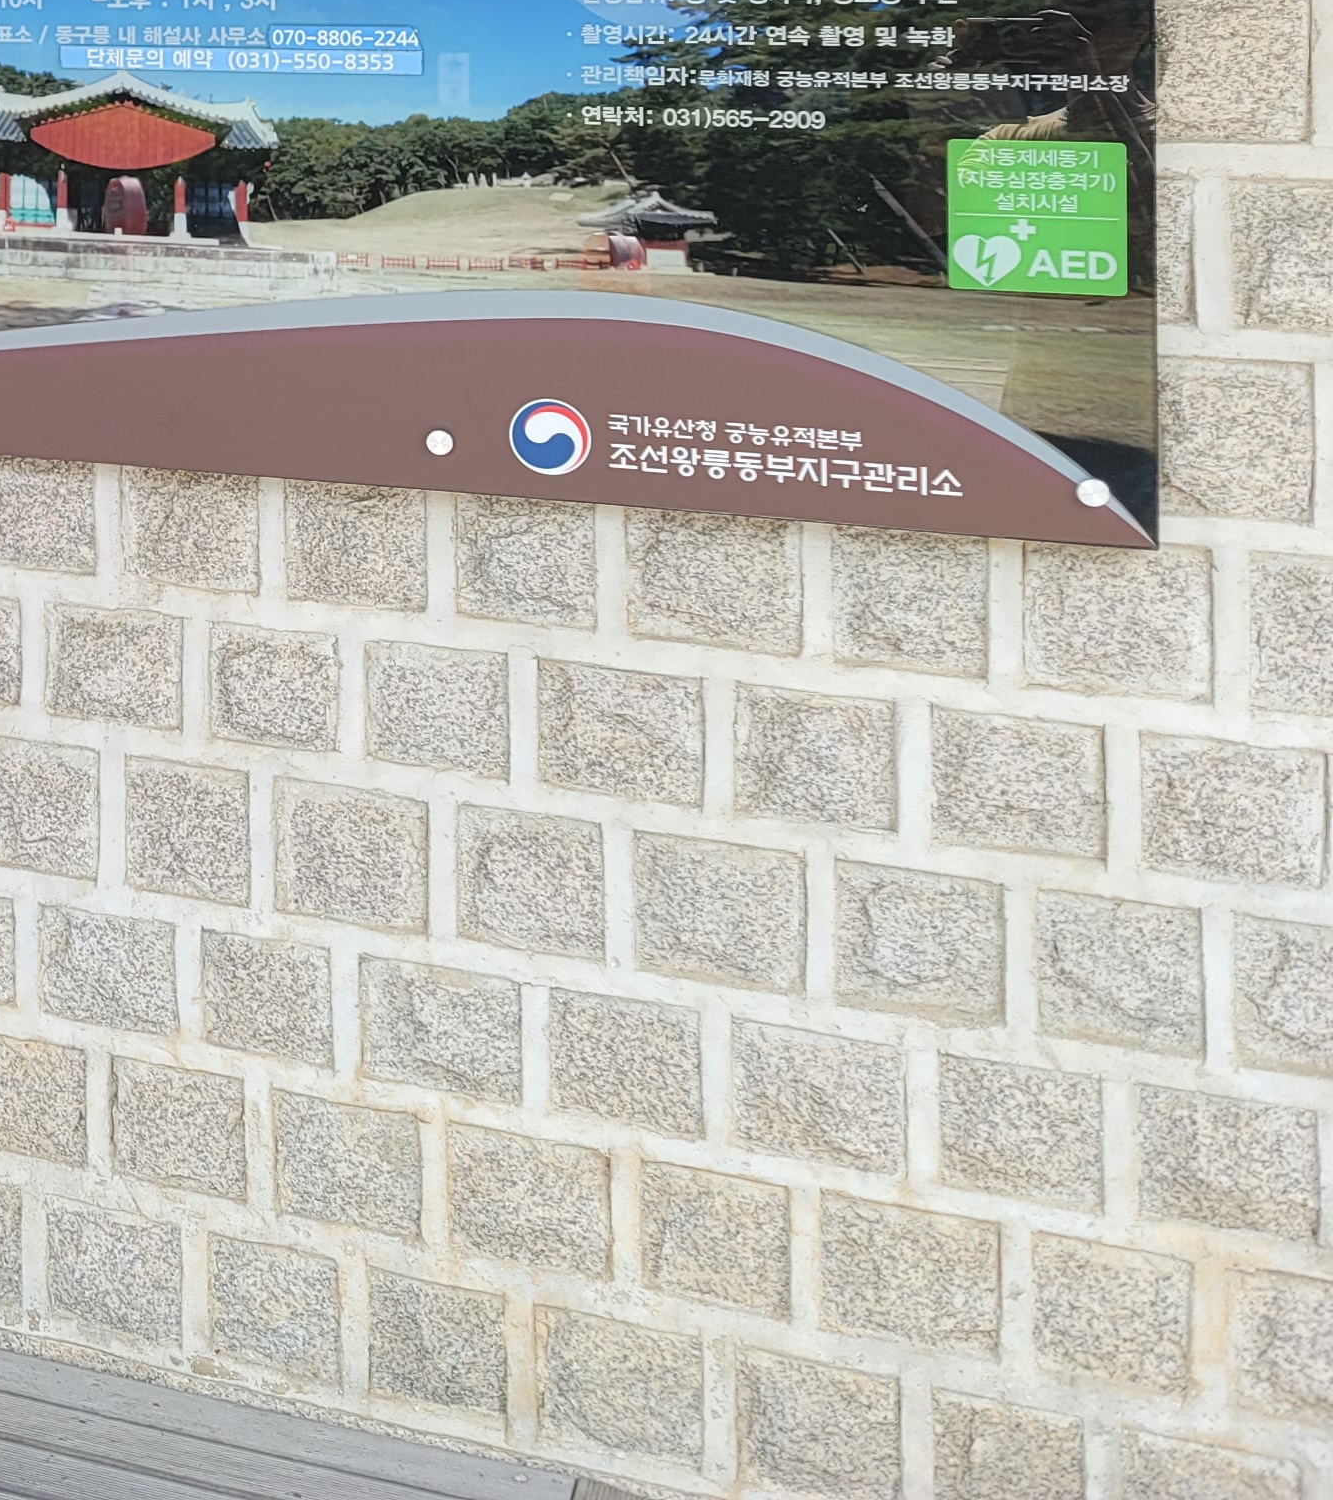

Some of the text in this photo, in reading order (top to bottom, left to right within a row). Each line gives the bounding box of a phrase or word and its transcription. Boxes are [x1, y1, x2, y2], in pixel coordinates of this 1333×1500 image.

[54, 25, 111, 45] 동구릉
[118, 26, 137, 45] 내
[143, 26, 201, 46] 해설사
[207, 27, 266, 47] 사무소
[272, 29, 419, 47] 070-8806-2244
[580, 25, 956, 48] 촬영시간: 24시간 연속 촬영 및 녹화
[87, 48, 395, 72] 단체문의 예약 (031)-550-8353
[776, 70, 888, 89] 궁능유적본부
[893, 72, 1130, 93] 조선왕릉동부지구관리소장
[581, 106, 826, 130] 연락처: 031)565-2909
[978, 148, 1099, 169] 자동제세동기
[958, 170, 1117, 193] (자동심장충격기)
[995, 192, 1078, 213] 설치시설
[1027, 249, 1118, 281] AED
[607, 413, 864, 451] 국가유산청 궁능유적본부
[608, 442, 965, 497] 조선왕릉동부지구관리소
